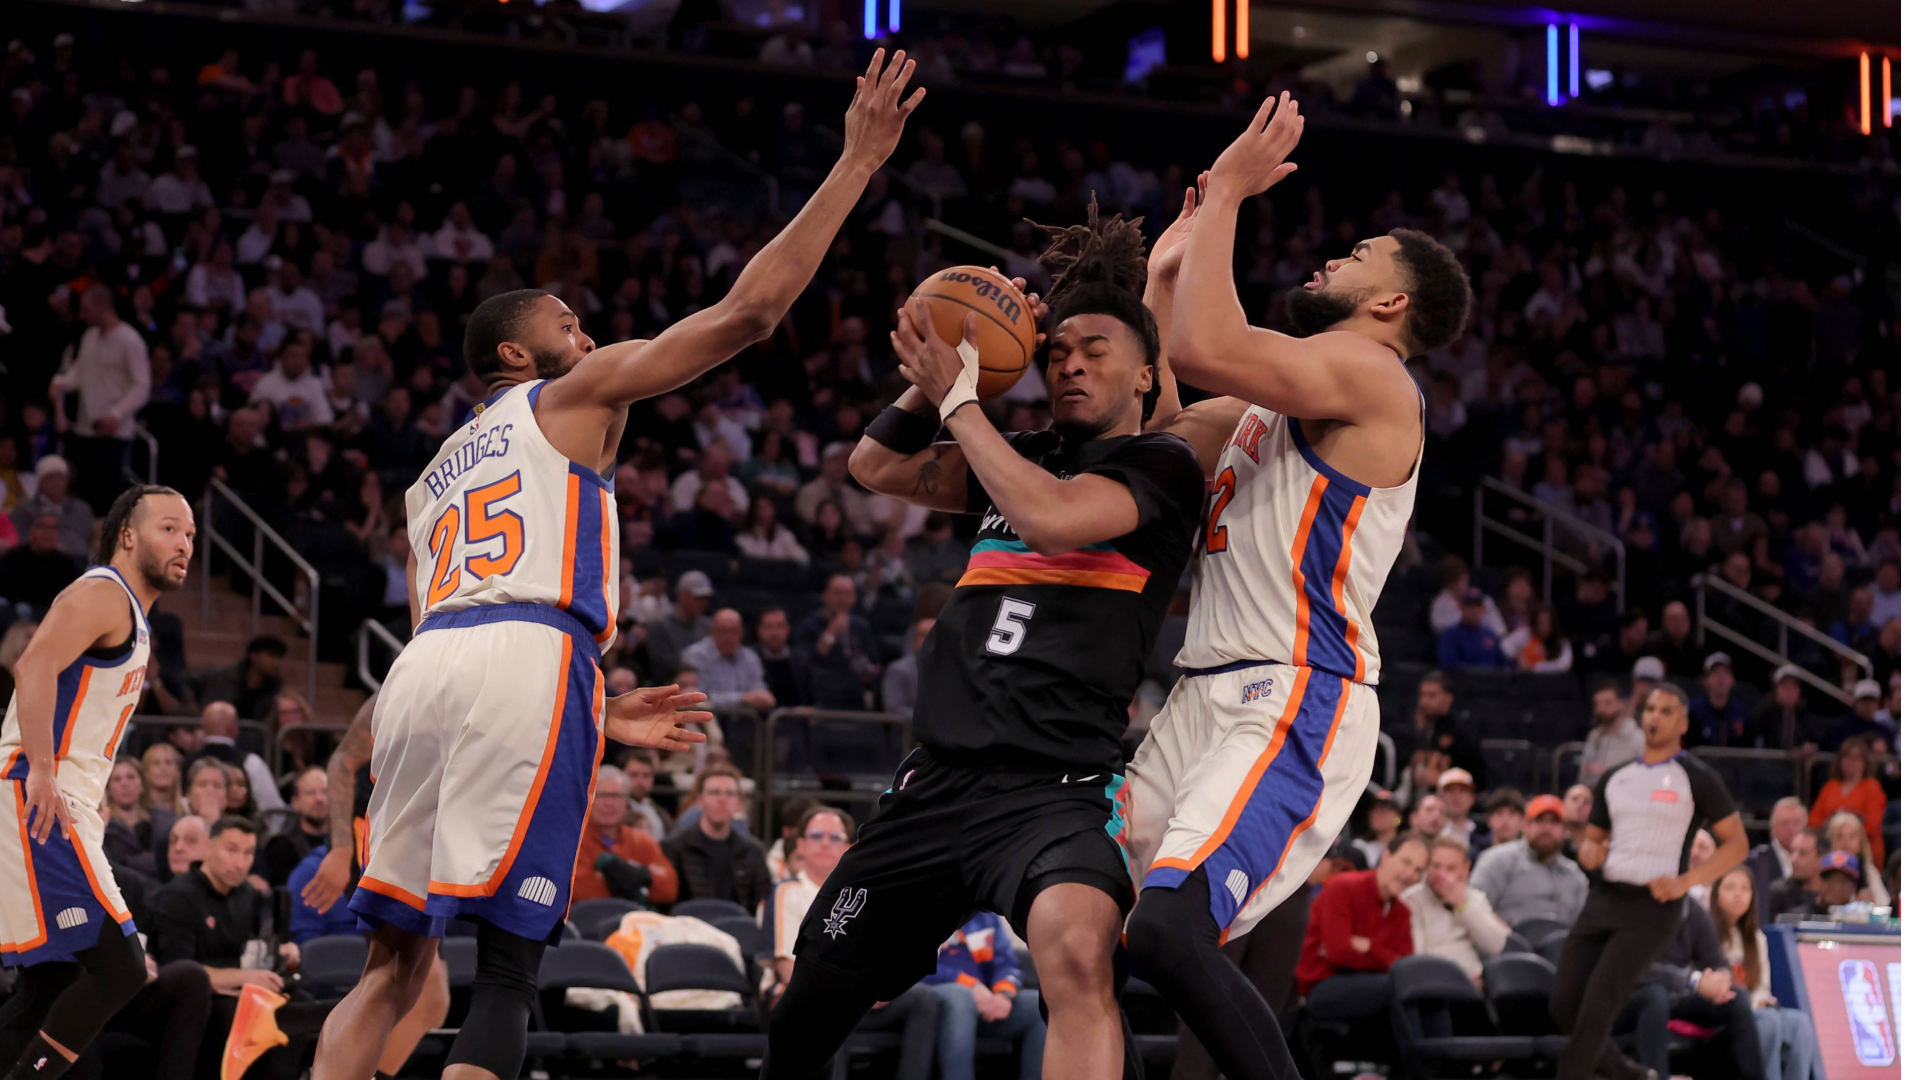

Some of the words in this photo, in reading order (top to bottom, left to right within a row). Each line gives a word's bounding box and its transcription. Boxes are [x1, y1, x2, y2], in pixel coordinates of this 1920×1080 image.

[940, 272, 1021, 325] Wilson
[424, 423, 513, 501] BRIDGES
[426, 469, 525, 611] 25
[1206, 465, 1236, 555] 2
[985, 595, 1036, 656] 5
[1241, 678, 1273, 704] NYC
